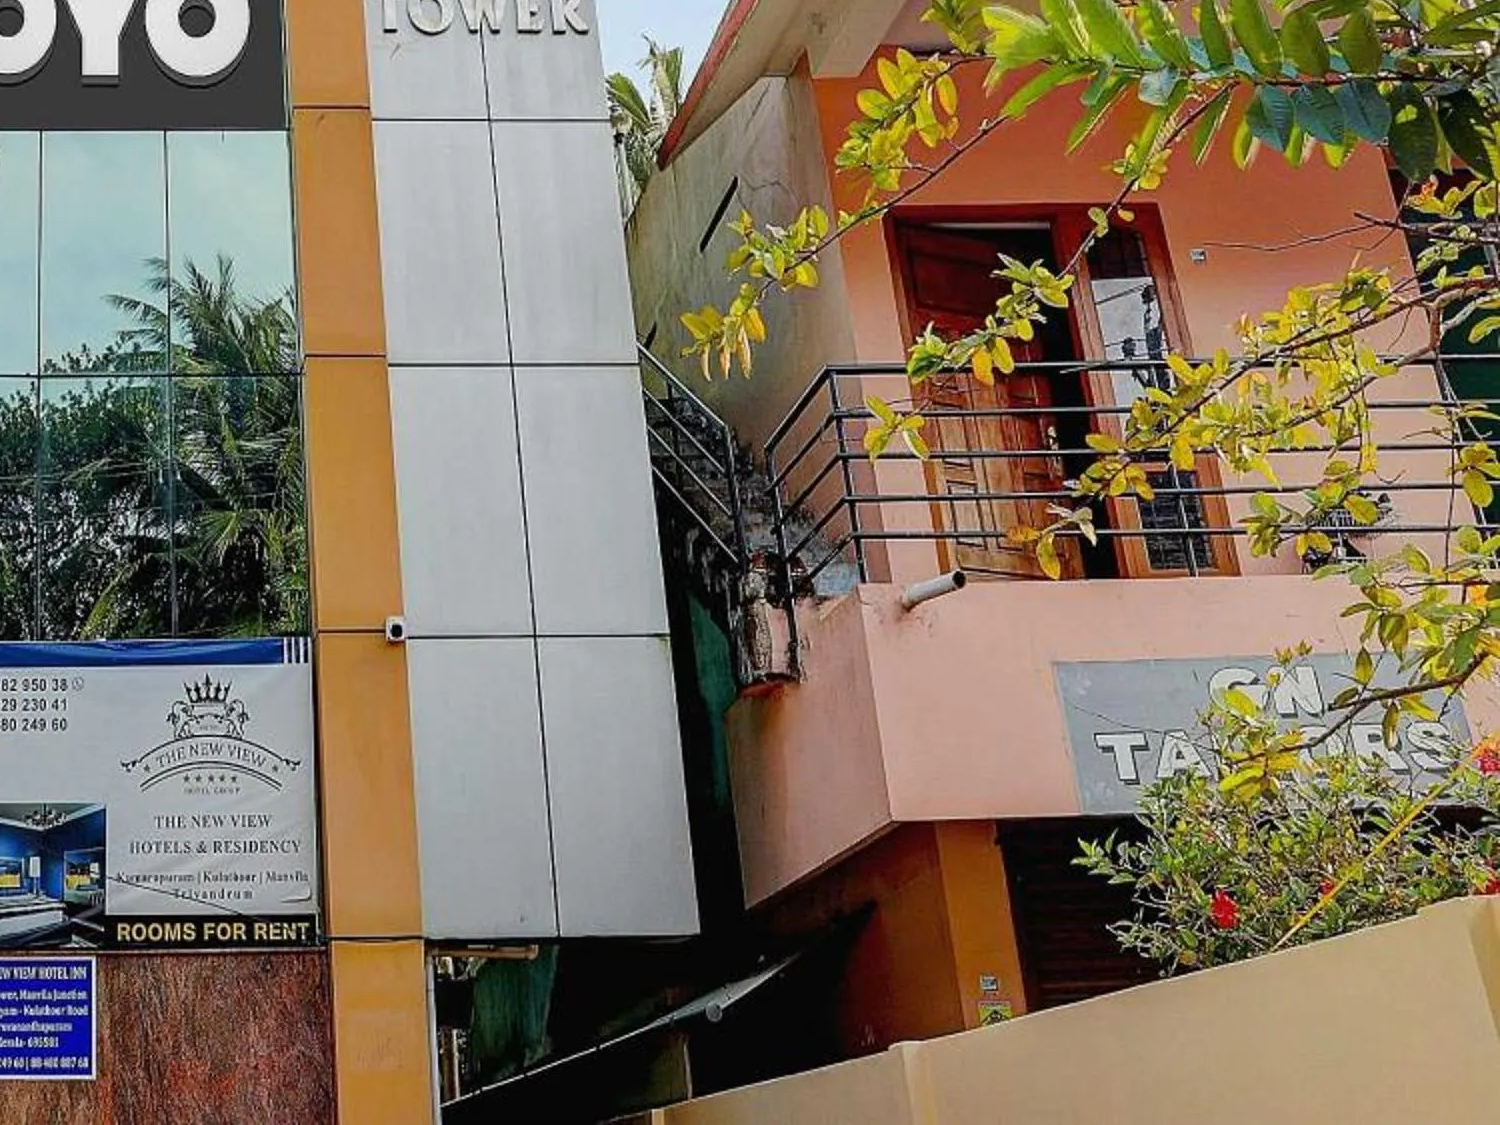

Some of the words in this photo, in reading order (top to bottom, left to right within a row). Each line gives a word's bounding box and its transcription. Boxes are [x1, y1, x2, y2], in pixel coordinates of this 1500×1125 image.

[22, 678, 47, 692] 950
[51, 678, 68, 692] 38
[22, 698, 47, 712] 230
[51, 698, 68, 712] 41
[22, 718, 47, 732] 249
[51, 718, 68, 732] 60
[155, 746, 186, 768] THE
[189, 742, 223, 758] NEW
[227, 742, 267, 768] VIEW
[154, 815, 187, 829] THE
[191, 815, 225, 829] NEW
[229, 814, 273, 828] VIEW
[129, 840, 192, 855] HOTELS
[195, 841, 208, 854] &
[213, 839, 301, 855] RESIDENCY
[173, 887, 253, 900] Trivandrum
[117, 922, 197, 942] ROOMS
[203, 922, 247, 941] FOR
[253, 922, 311, 941] RENT
[39, 967, 69, 980] HOTEL
